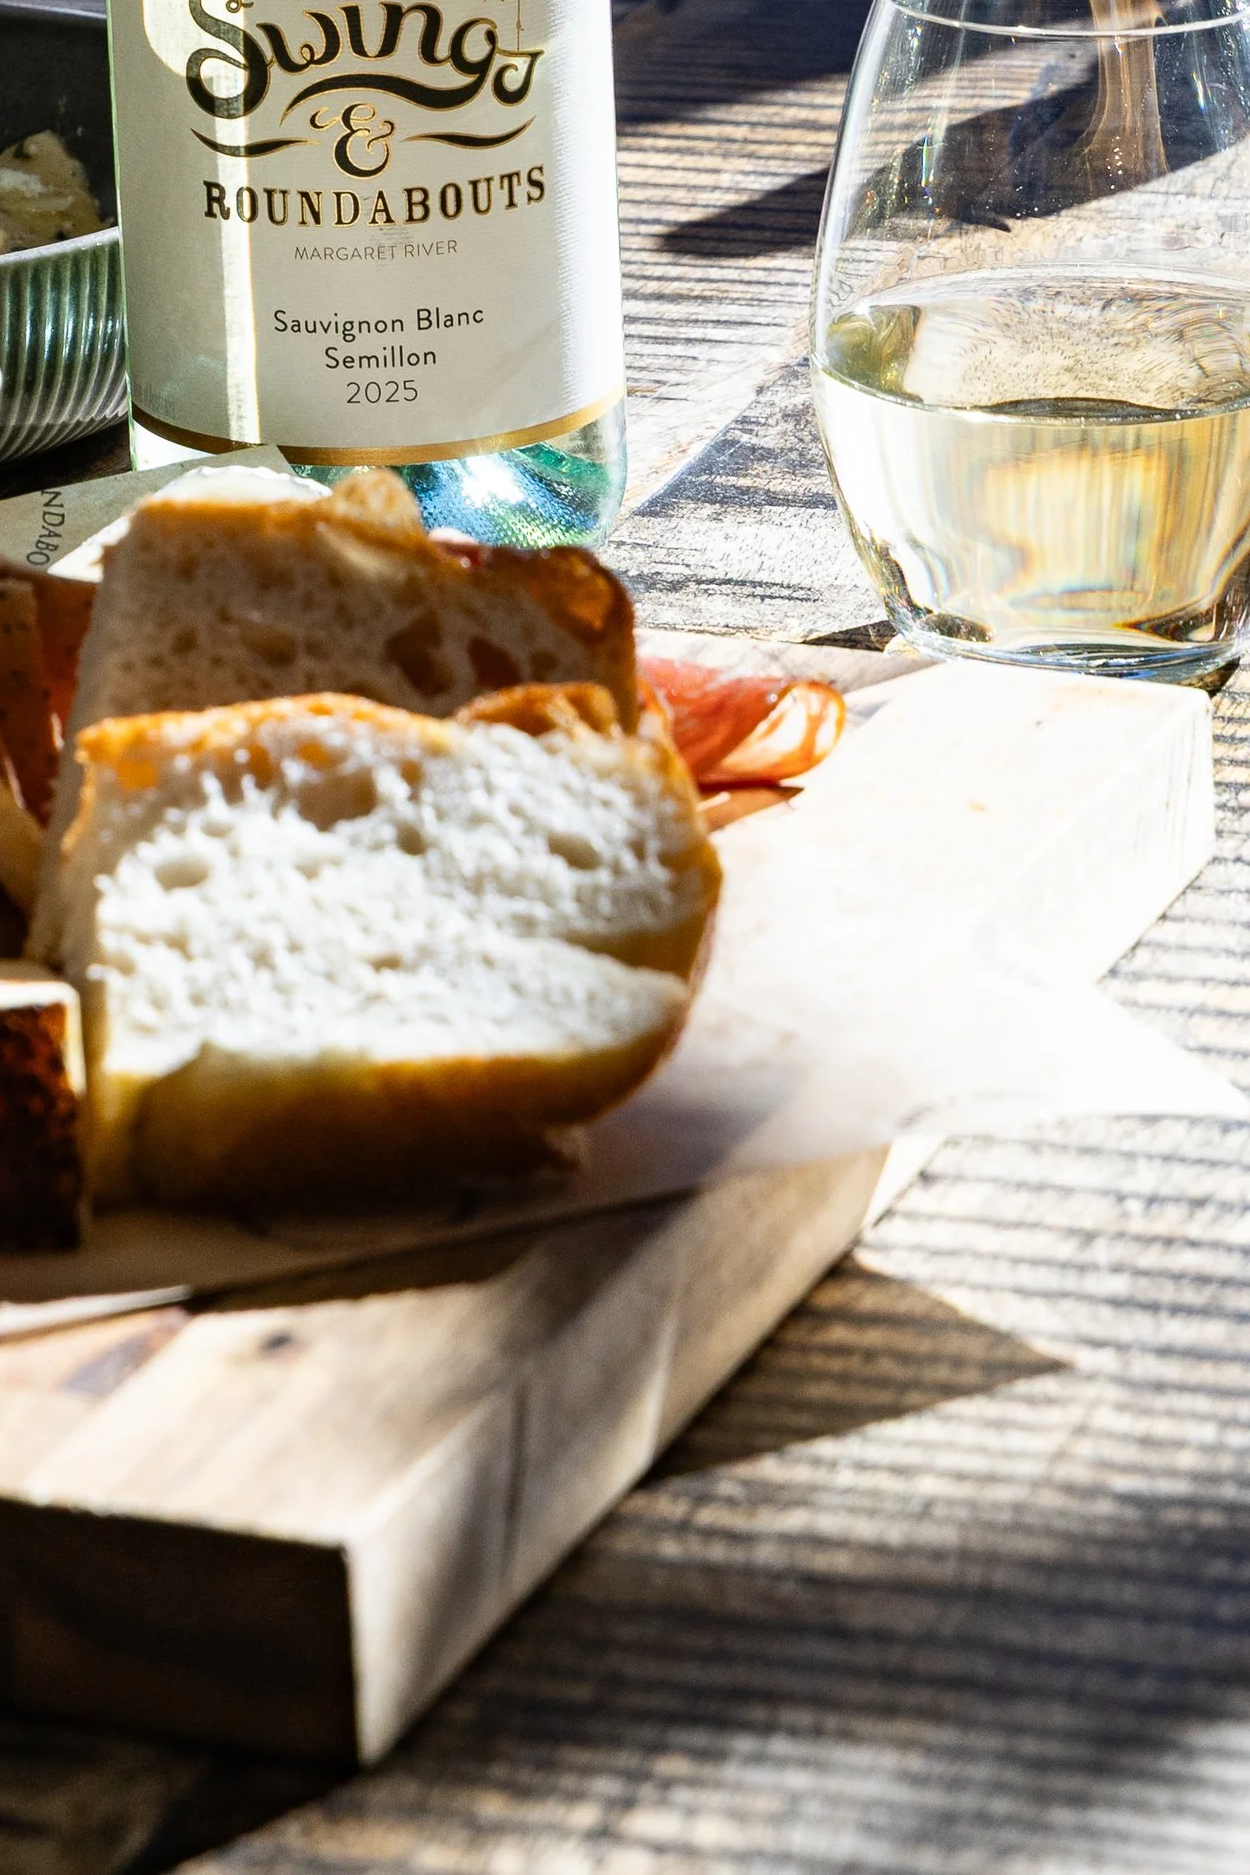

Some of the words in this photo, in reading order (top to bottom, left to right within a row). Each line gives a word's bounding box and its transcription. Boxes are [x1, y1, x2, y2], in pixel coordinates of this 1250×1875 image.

[309, 102, 395, 179] &
[202, 163, 546, 228] ROUNDABOUTS
[293, 246, 398, 261] MARGARET
[404, 239, 458, 258] RIVER
[273, 309, 405, 343] Sauvignon
[416, 306, 485, 331] Blanc
[324, 345, 437, 369] Semillon
[346, 379, 419, 404] 2025
[25, 488, 67, 567] NDABO
